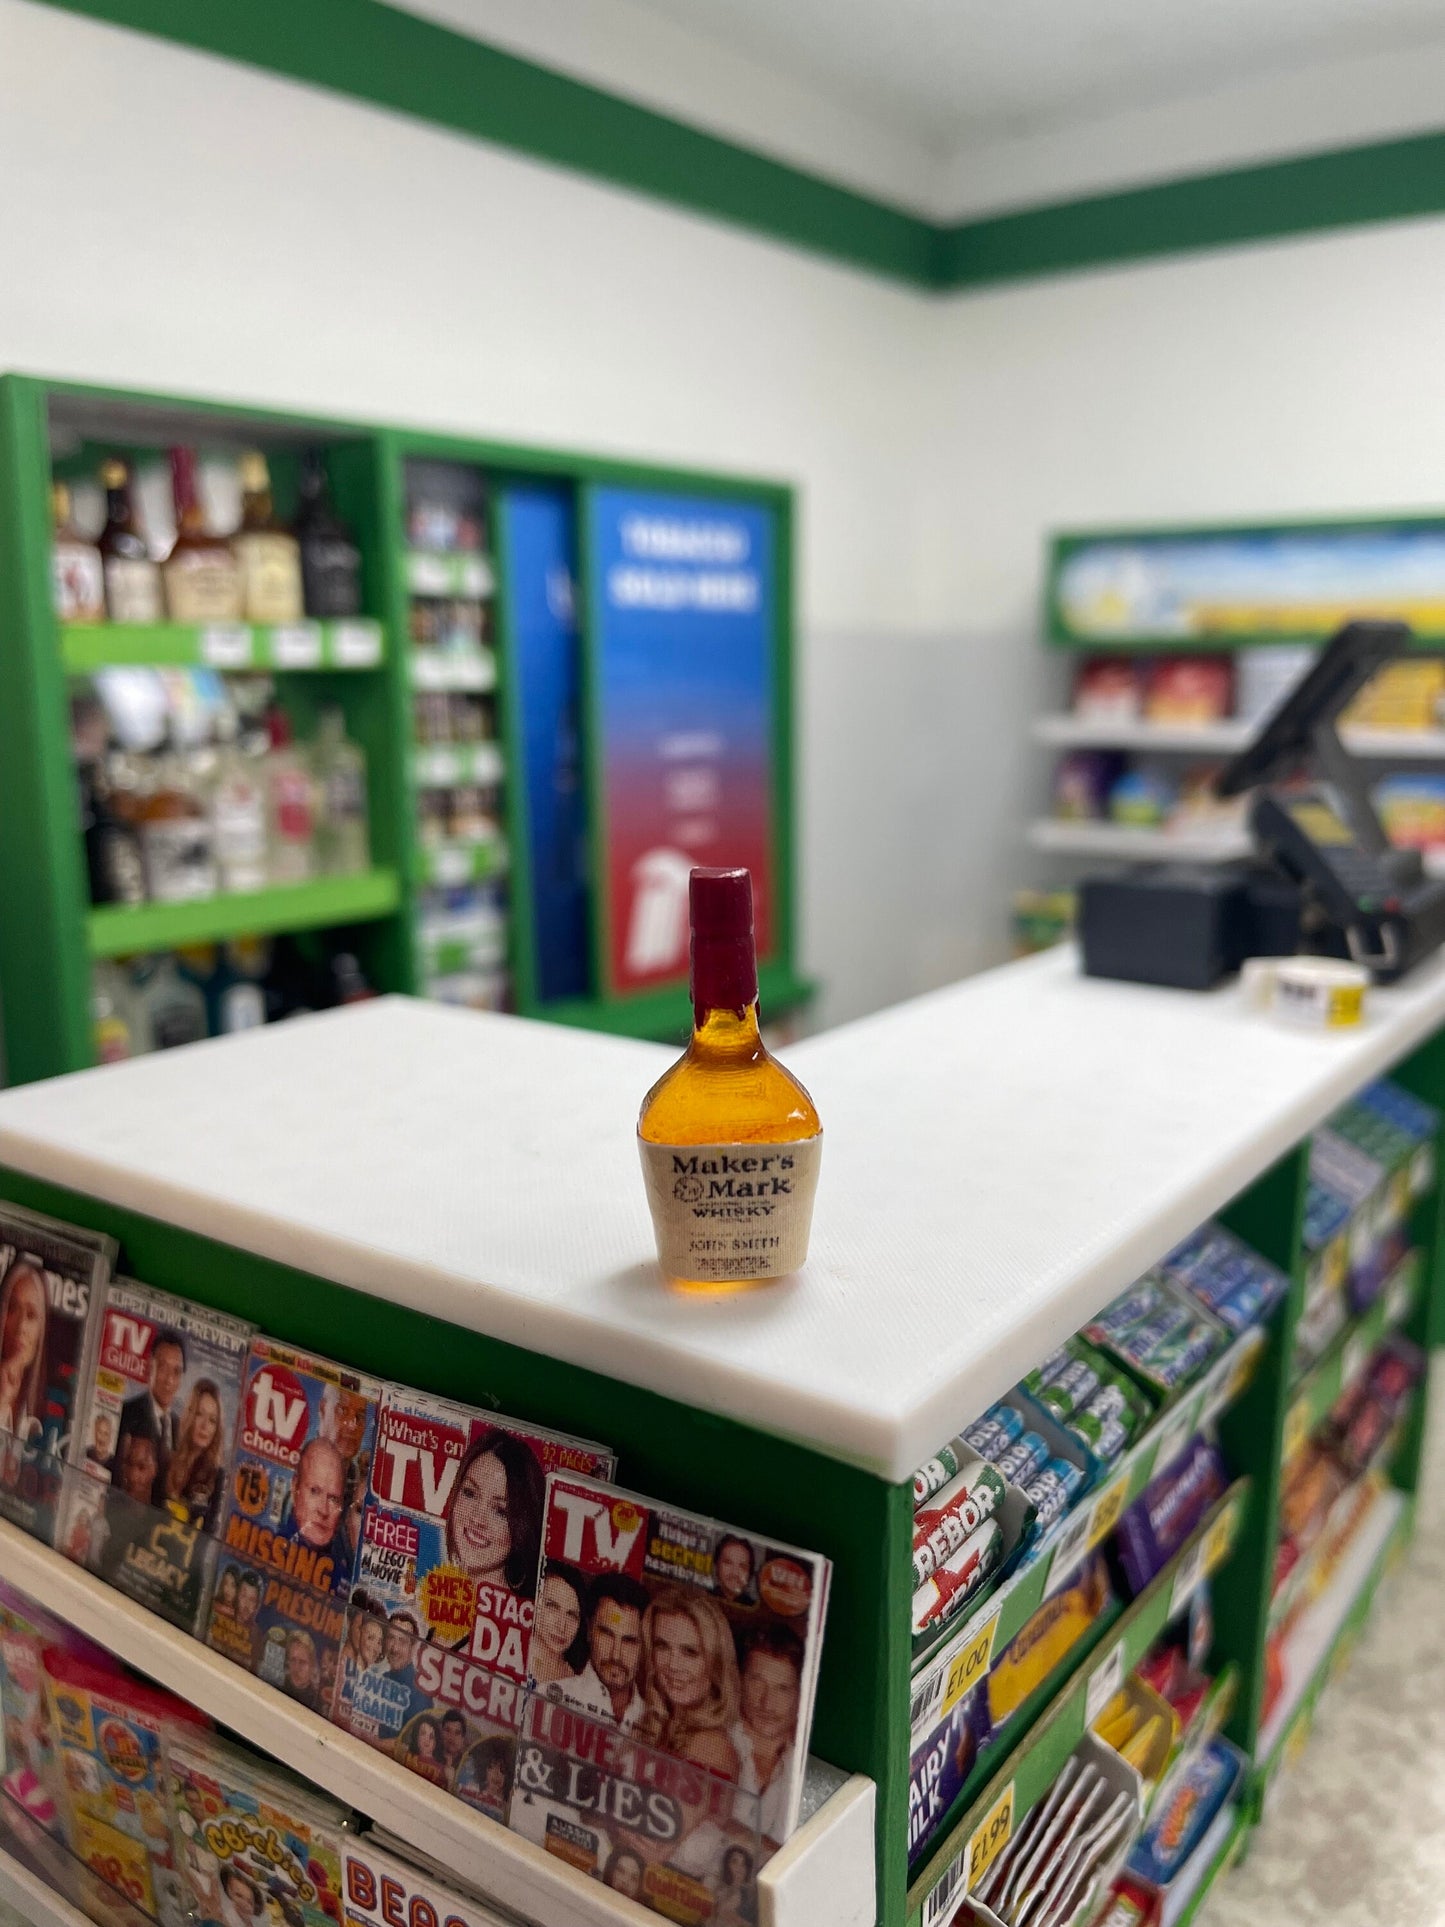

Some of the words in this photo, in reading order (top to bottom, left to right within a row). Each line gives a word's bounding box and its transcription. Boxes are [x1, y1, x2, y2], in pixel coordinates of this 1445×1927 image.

[672, 1154, 795, 1175] Maker's
[708, 1176, 792, 1200] Mark
[692, 1205, 776, 1218] WHISKY
[110, 1314, 152, 1356] TV
[106, 1347, 149, 1377] GUIDE
[252, 1372, 307, 1440] tv
[243, 1431, 301, 1464] choice
[386, 1417, 439, 1450] What's
[385, 1440, 461, 1517] TV
[560, 1451, 593, 1473] PAGES
[553, 1489, 643, 1575] TV
[427, 1573, 473, 1603] SHE'S
[428, 1599, 472, 1627] BACK
[946, 1637, 989, 1699] £1.00
[520, 1748, 554, 1794] &
[566, 1762, 676, 1840] LIES
[971, 1804, 1011, 1877] £1.99
[206, 1821, 314, 1901] CBeebies
